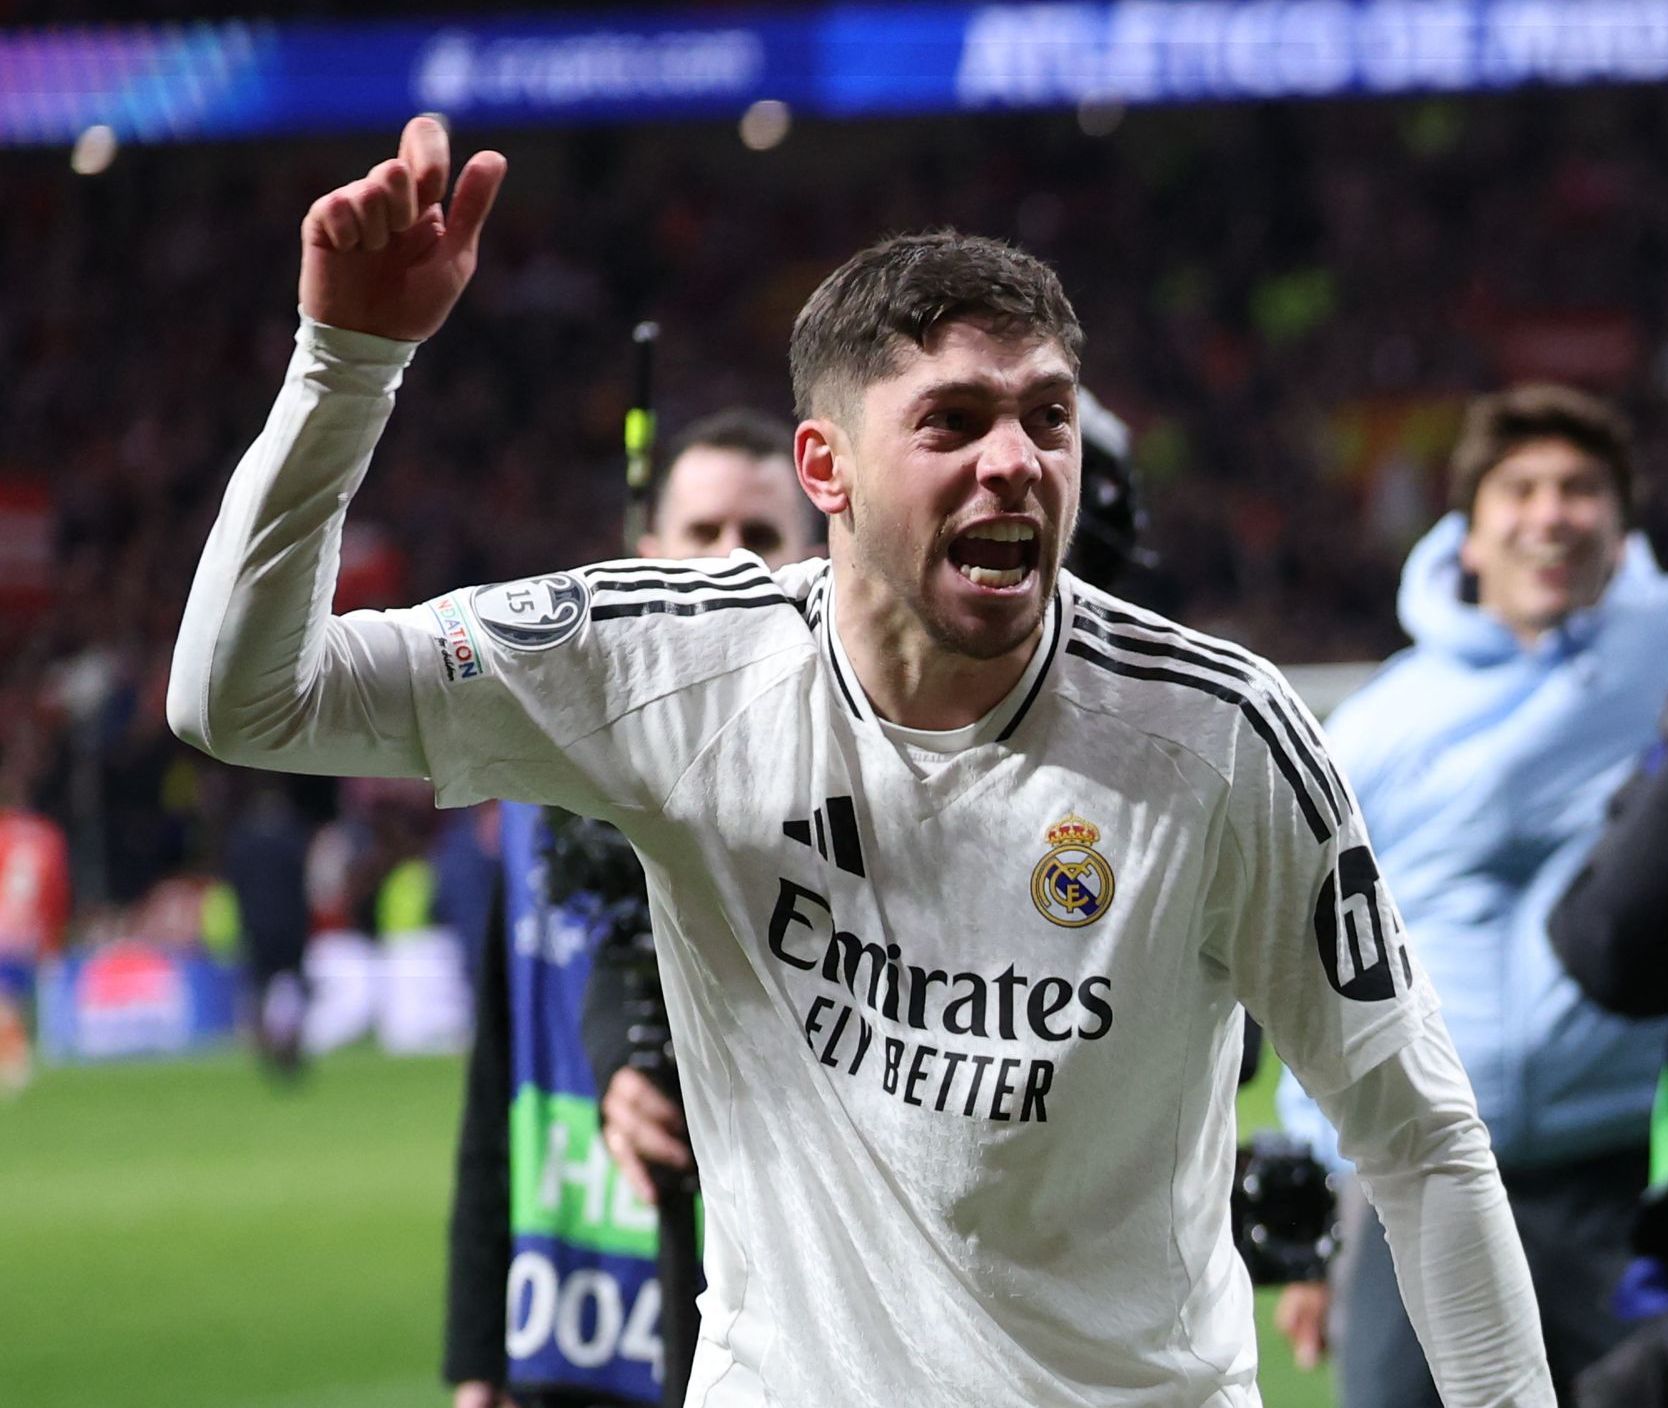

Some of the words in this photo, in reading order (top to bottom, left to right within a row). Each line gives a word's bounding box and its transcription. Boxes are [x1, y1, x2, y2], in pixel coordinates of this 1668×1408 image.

[506, 589, 535, 614] 15
[768, 877, 1113, 1041] Emirates
[805, 996, 872, 1076] FLY
[882, 1036, 1055, 1122] BETTER
[506, 1251, 665, 1385] 004
